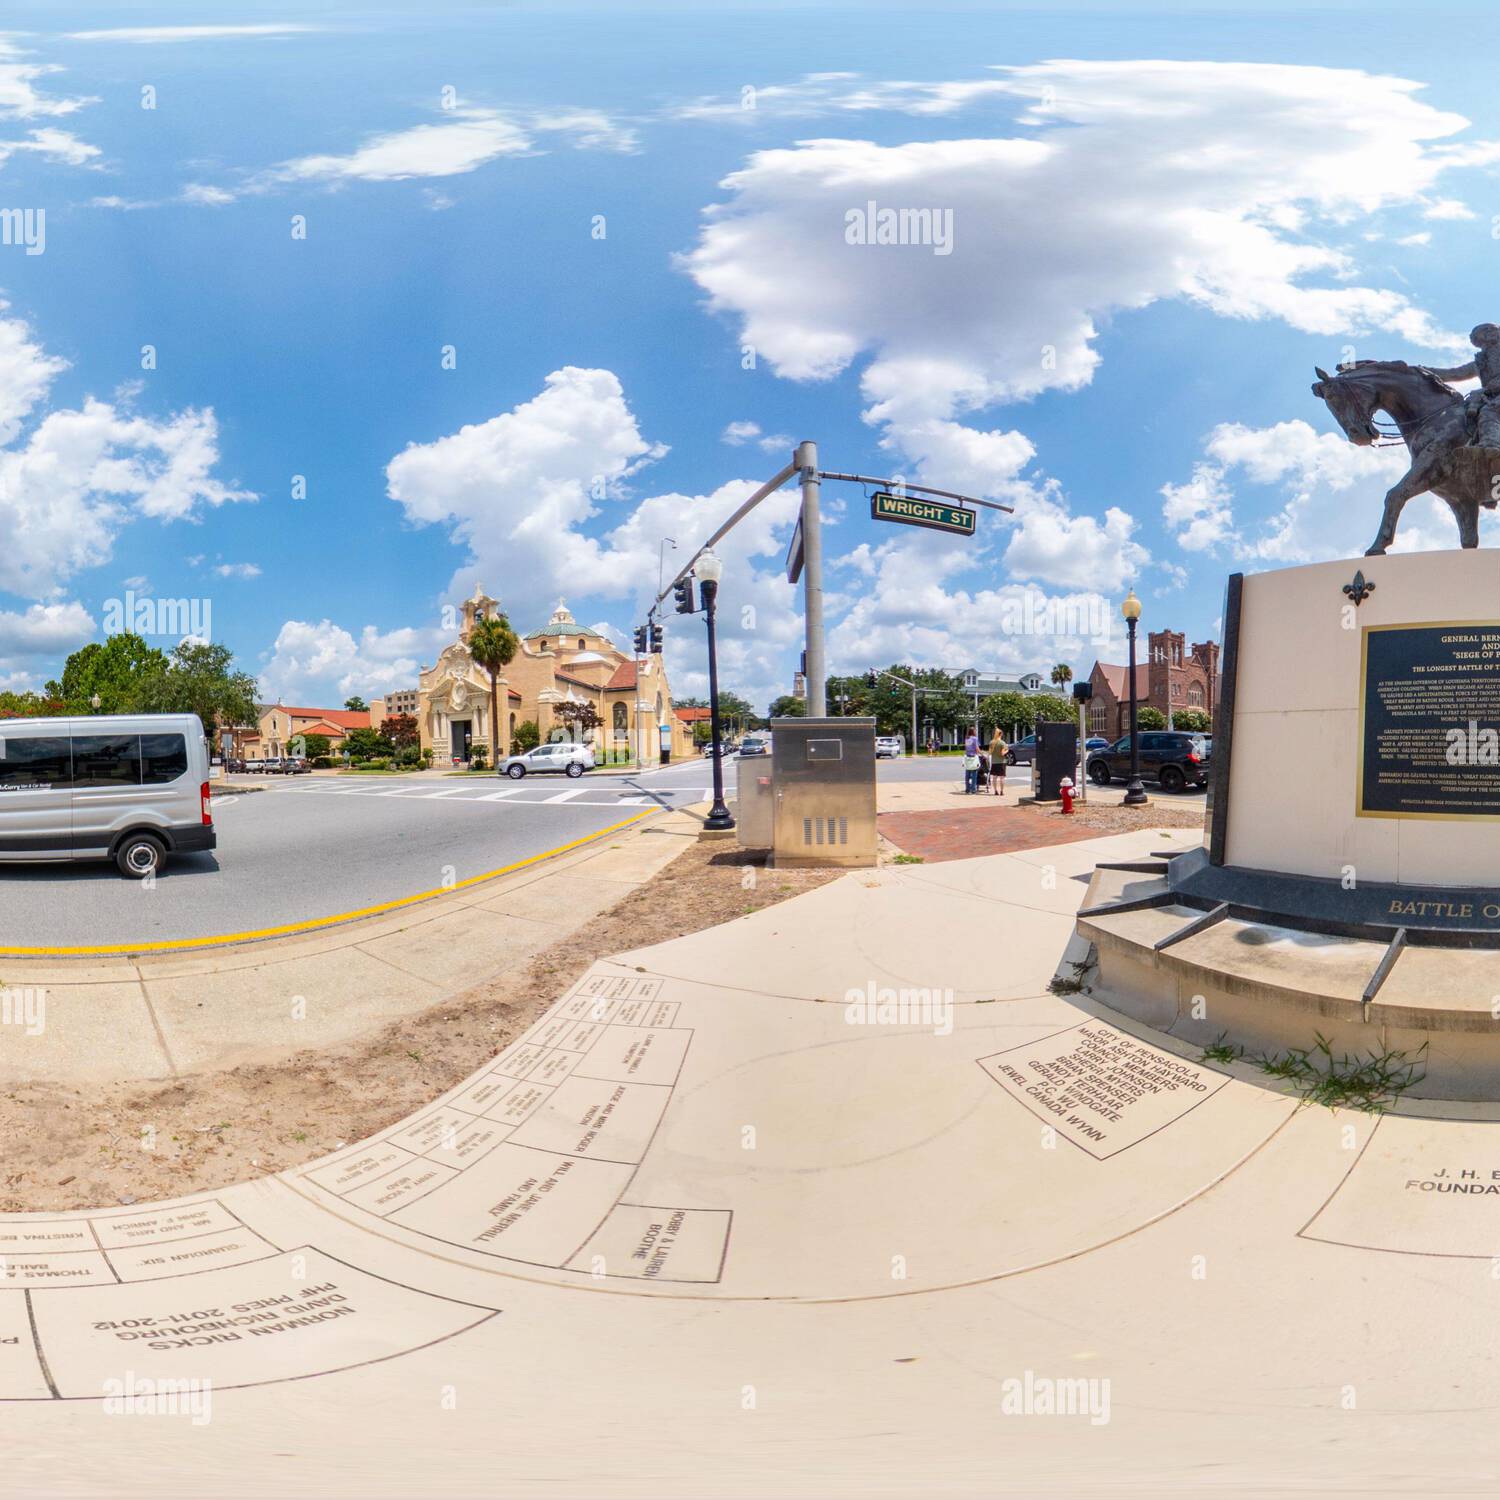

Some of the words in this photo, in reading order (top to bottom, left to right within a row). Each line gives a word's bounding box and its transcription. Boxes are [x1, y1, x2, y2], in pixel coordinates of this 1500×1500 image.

[883, 499, 944, 519] WRIGHT
[951, 512, 969, 525] ST
[1388, 901, 1473, 917] BATTLE
[1077, 1027, 1110, 1046] MAYOR
[1107, 1044, 1151, 1067] ASHTON
[1149, 1064, 1208, 1092] HAYWARD
[1080, 1038, 1121, 1064] COUNCIL
[1120, 1061, 1180, 1091] MEMBERS
[1096, 1028, 1121, 1042] CITY
[1118, 1040, 1137, 1049] OF
[1134, 1047, 1201, 1080] PENSACOLA
[1054, 1055, 1087, 1076] BRIAN
[1083, 1073, 1138, 1105] SPENSER
[1068, 1052, 1107, 1076] SHERRI
[1103, 1073, 1146, 1097] MYERS
[1074, 1045, 1109, 1066] LARRY
[1105, 1065, 1163, 1095] JOHNSON
[609, 1085, 626, 1102] JUDGE
[1027, 1059, 1067, 1087] GERALD
[1063, 1084, 1123, 1123] WINDGATE
[1044, 1061, 1075, 1079] ANDY
[1071, 1078, 1125, 1111] TERHAAR
[601, 1102, 616, 1115] AND
[997, 1064, 1028, 1087] JEWEL
[1024, 1085, 1068, 1117] CANADA
[1065, 1114, 1107, 1142] WYNN
[1056, 1094, 1080, 1109] WU
[578, 1104, 601, 1126] VINSON
[574, 1130, 598, 1153] ROGER
[552, 1160, 575, 1176] WILL
[1434, 1168, 1449, 1178] J.
[1461, 1169, 1480, 1179] H.
[517, 1177, 538, 1192] AND
[537, 1176, 559, 1193] AND
[487, 1192, 522, 1218] FAMILY
[515, 1193, 542, 1211] JANE
[472, 1211, 522, 1242] MERRILL
[664, 1210, 686, 1236] ROBBY
[631, 1223, 663, 1260] BOOTHE
[25, 1269, 93, 1278] THOMAS
[641, 1245, 671, 1278] LAUREN
[299, 1281, 338, 1298] PHF
[230, 1293, 294, 1313] PRES
[283, 1293, 348, 1314] DAVID
[92, 1307, 225, 1331] 2011-2012
[114, 1311, 281, 1341] RICHBOURG
[247, 1305, 356, 1337] NORMAN
[147, 1331, 243, 1350] RICKS
